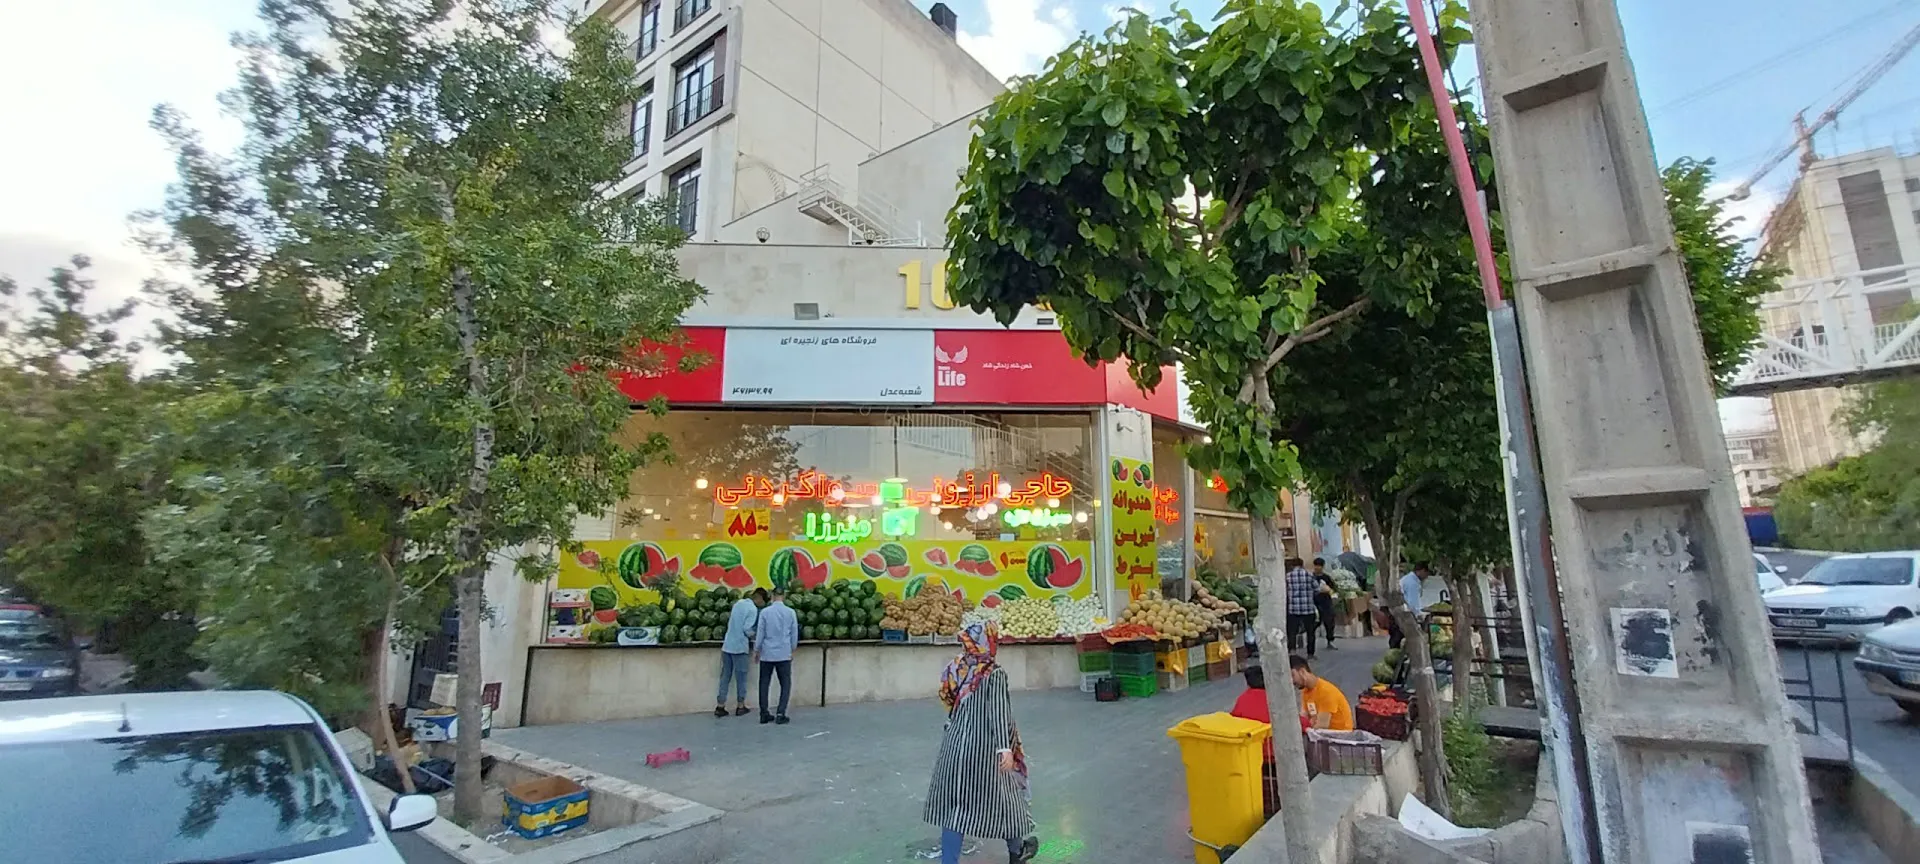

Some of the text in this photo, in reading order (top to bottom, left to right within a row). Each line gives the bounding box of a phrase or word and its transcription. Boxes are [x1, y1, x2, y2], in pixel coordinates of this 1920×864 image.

[780, 336, 877, 346] فروشگاه های زنجیره ای
[937, 370, 966, 387] Life
[880, 385, 922, 397] شعبه عدل
[1002, 472, 1073, 507] حاجی
[1112, 489, 1152, 515] هندوانه
[806, 511, 873, 543] میرزا
[1114, 525, 1156, 548] شیرین
